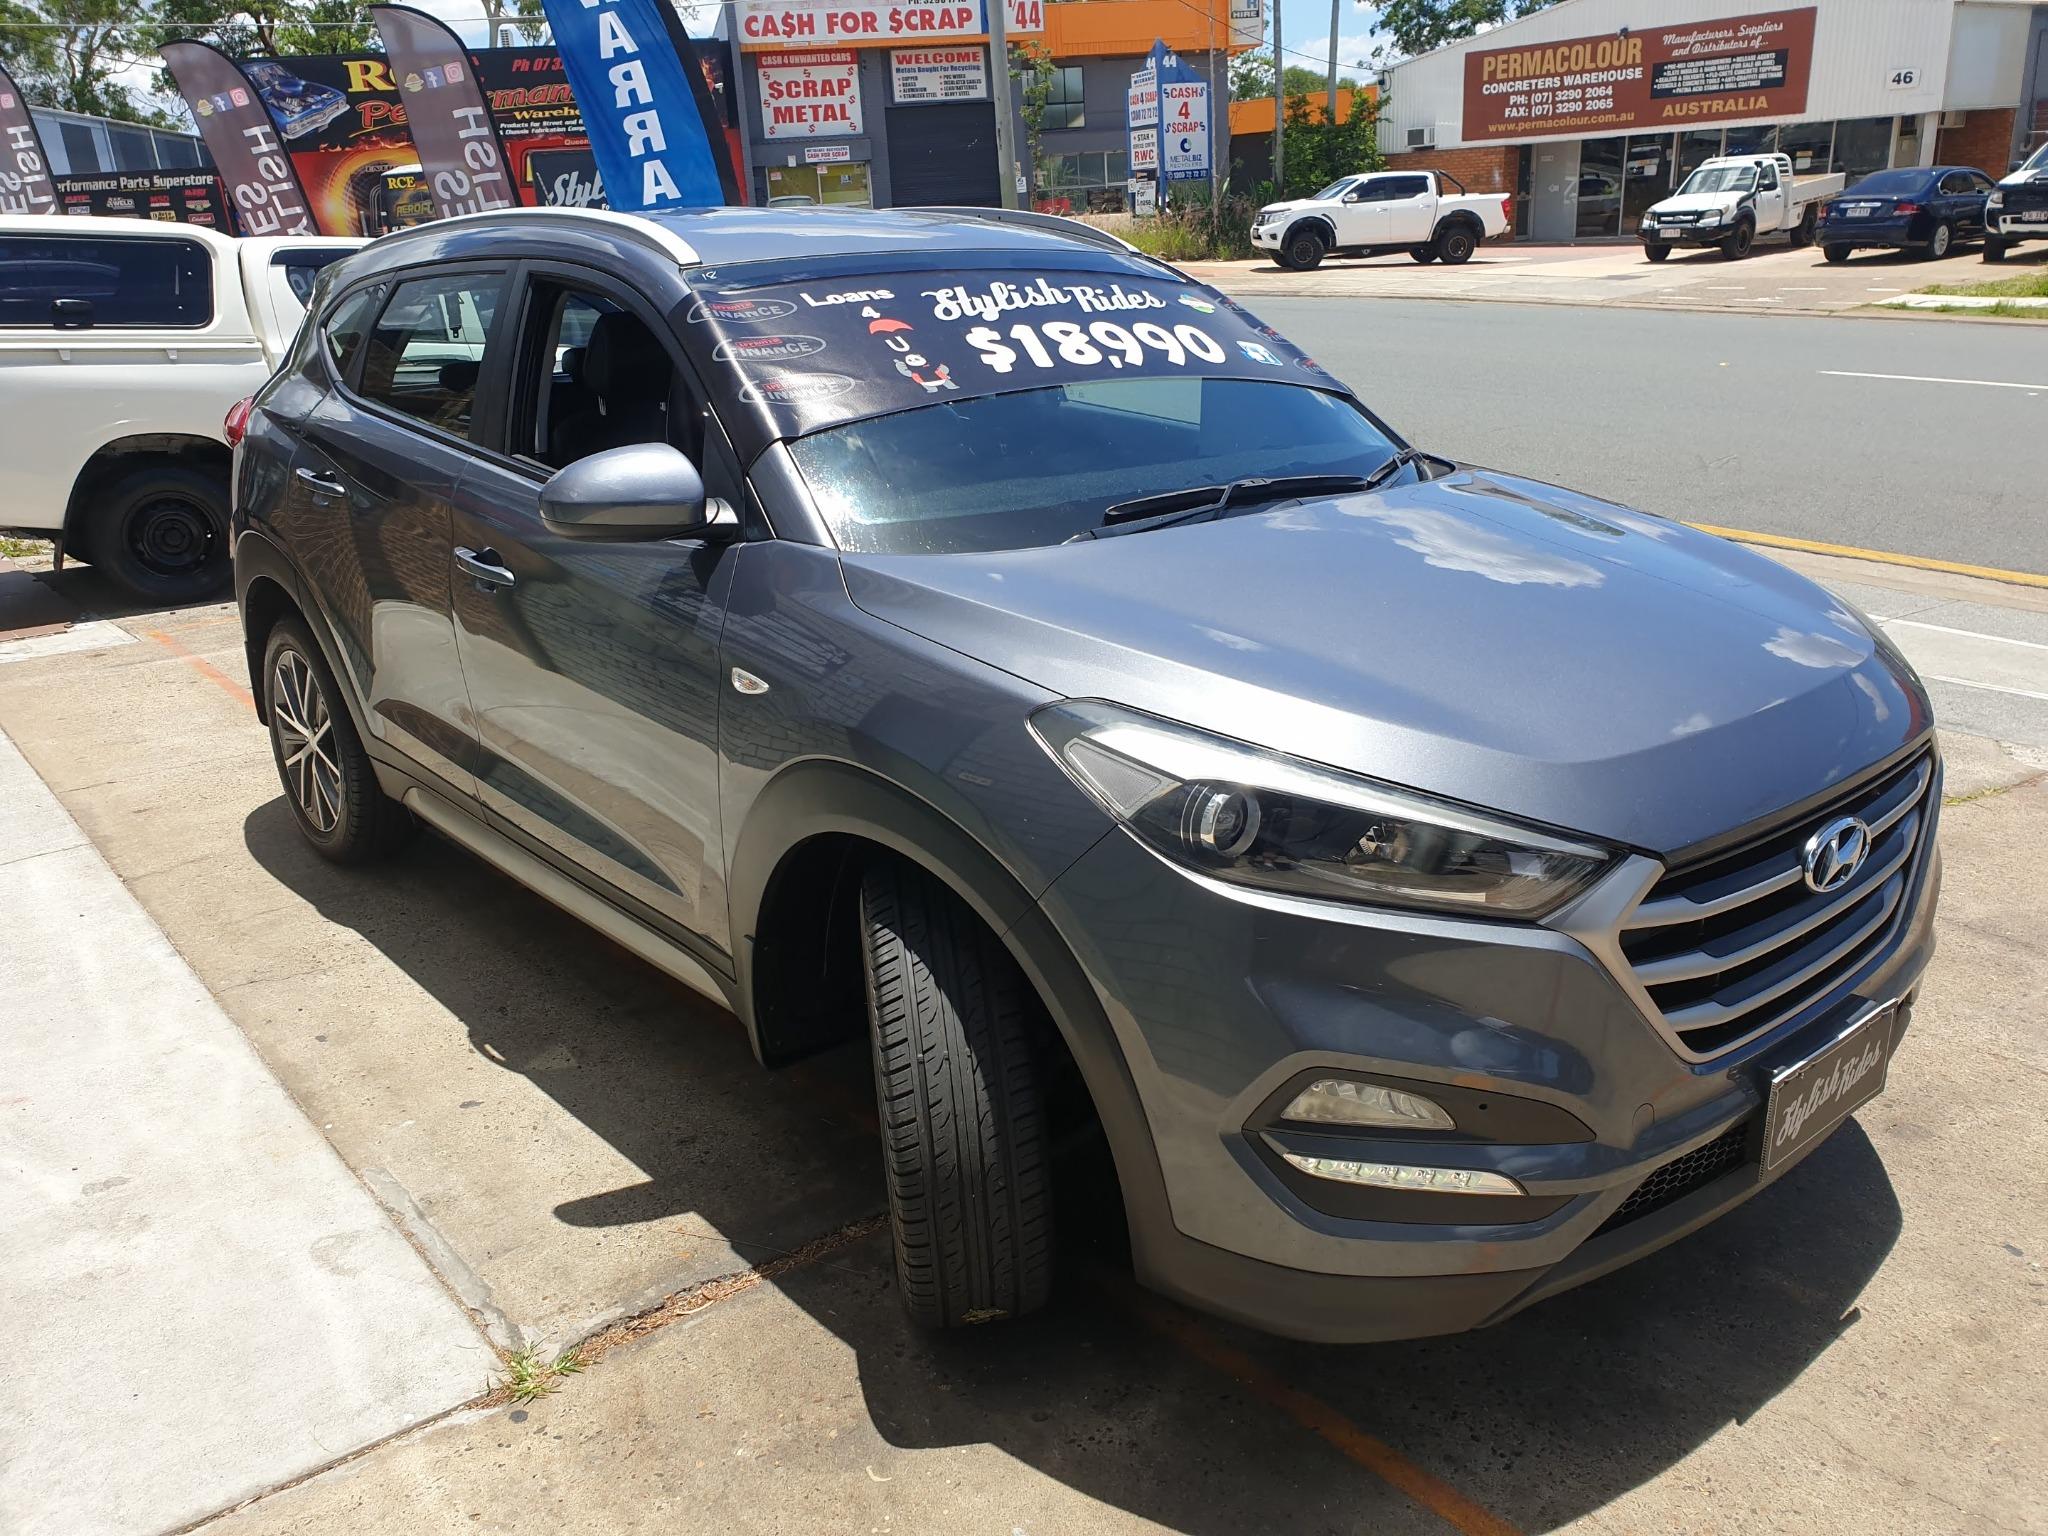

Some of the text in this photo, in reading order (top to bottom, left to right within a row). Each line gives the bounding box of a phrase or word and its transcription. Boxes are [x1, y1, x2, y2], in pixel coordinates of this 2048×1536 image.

[744, 7, 974, 38] CA$H FOR $CRAP
[1738, 21, 1784, 38] Suppliers
[1672, 45, 1690, 56] and
[1692, 39, 1748, 54] Distributors
[512, 59, 530, 72] Ph
[533, 58, 549, 71] 07
[762, 52, 851, 65] CASH 4 UNWANTED CARS
[896, 51, 981, 65] WELCOME
[1162, 55, 1177, 68] 44
[1483, 37, 1642, 80] PERMACOLOUR
[896, 66, 916, 74] Metals
[917, 65, 939, 74] Bought
[1483, 67, 1643, 94] CONCRETERS WAREHOUSE
[1891, 71, 1914, 85] 46
[768, 78, 851, 100] $CRAP
[1170, 86, 1198, 98] CASH
[1509, 85, 1613, 106] PH: (07) 3290 2064
[773, 103, 851, 124] METAL
[1178, 101, 1190, 119] 4
[1504, 98, 1613, 118] FAX: (07) 3290 2065
[1662, 95, 1768, 117] AUSTRALIA
[1488, 112, 1635, 132] www.permacolour.com.au
[564, 138, 591, 146] Queen
[1137, 133, 1150, 141] STAR
[1134, 149, 1154, 162] RWC
[119, 177, 150, 189] Parts
[153, 174, 213, 189] Superstore
[387, 176, 415, 190] RCE
[800, 287, 895, 307] Loans
[921, 278, 1166, 321] Stylish Rides
[700, 305, 785, 318] FINANCE
[861, 306, 881, 318] 4
[729, 342, 813, 356] FINANCE
[885, 336, 910, 352] U
[965, 321, 1226, 373] $18,990
[1776, 1039, 1882, 1147] Stylish Rides
